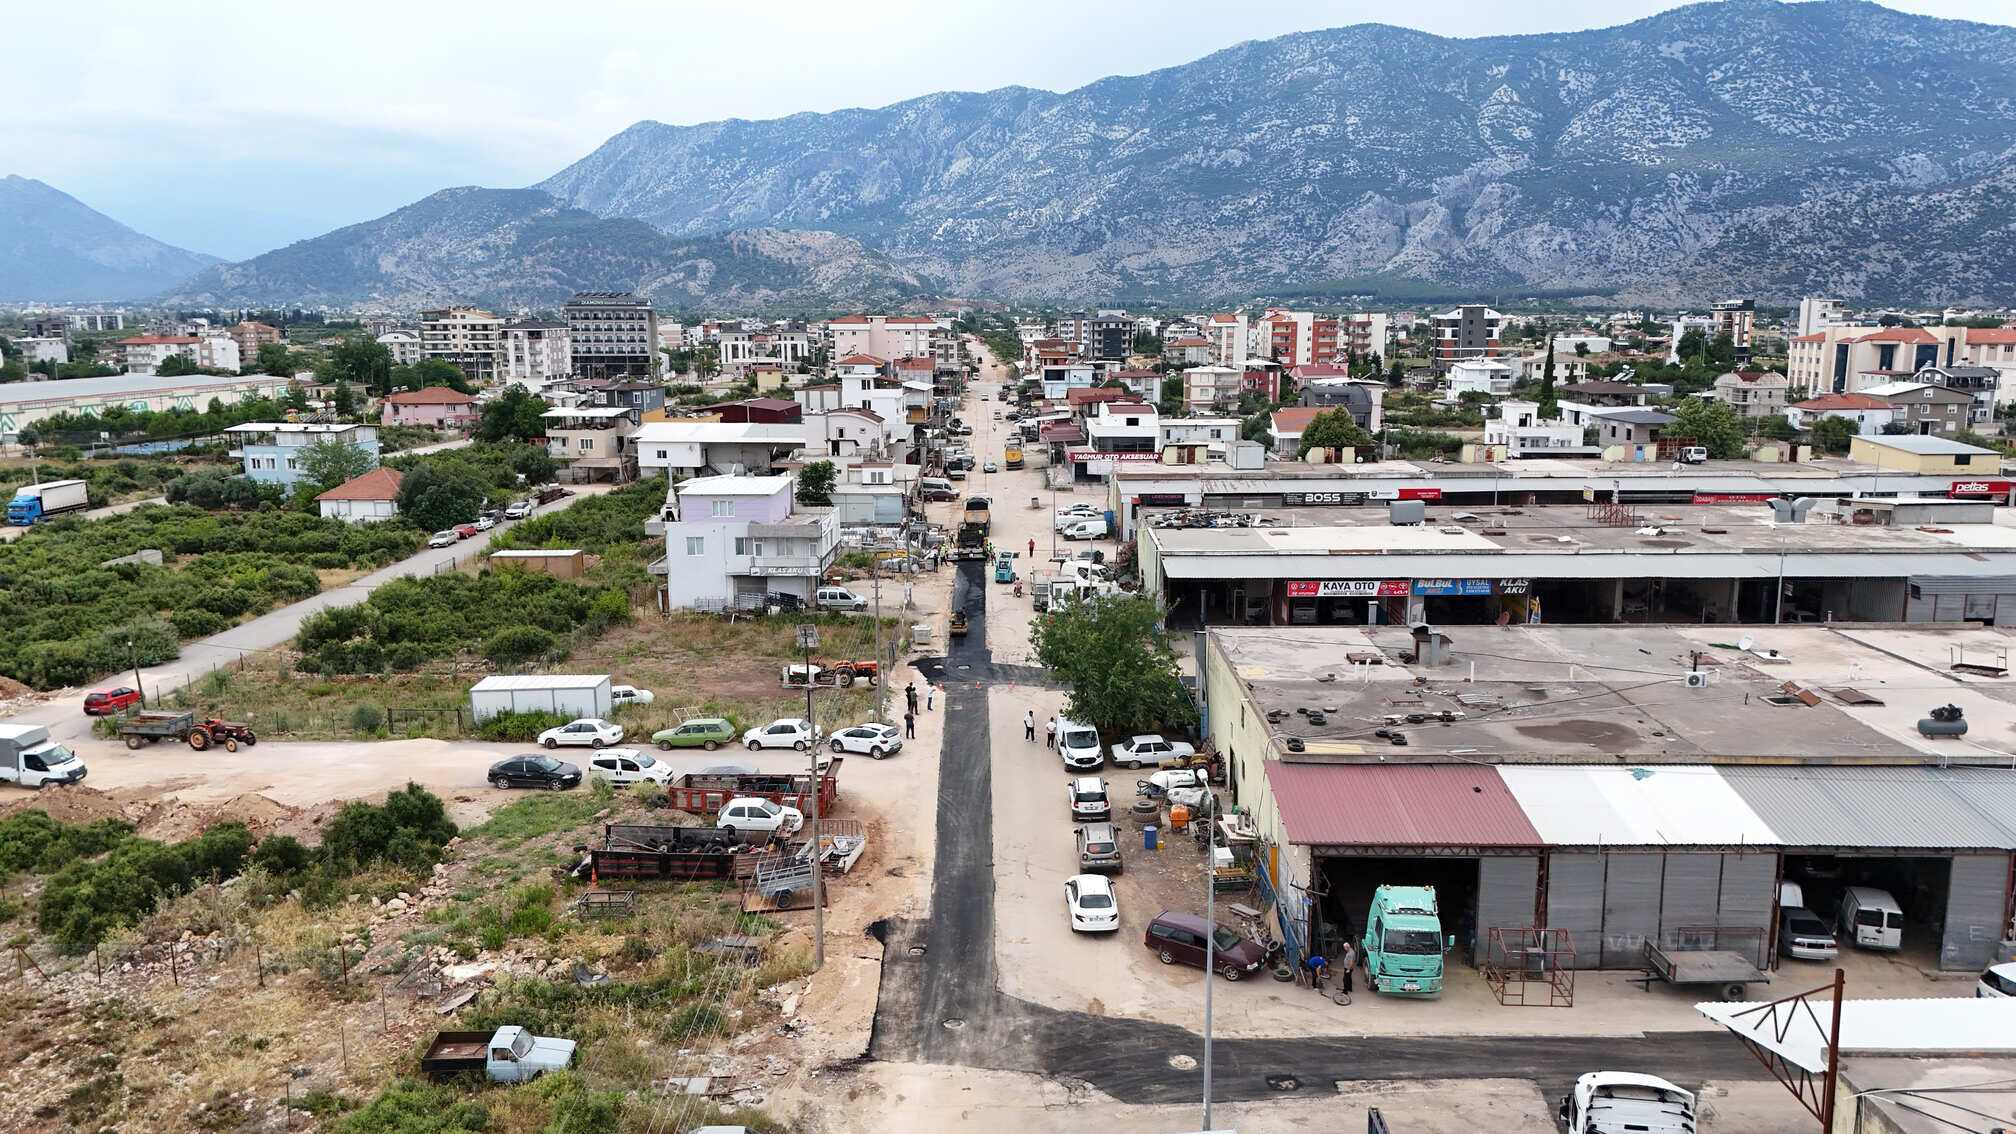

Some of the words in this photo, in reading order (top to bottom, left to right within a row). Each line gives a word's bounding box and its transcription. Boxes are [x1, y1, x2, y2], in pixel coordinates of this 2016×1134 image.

[1074, 452, 1103, 460] YAĞMUR
[1305, 493, 1341, 502] BOSS
[1323, 582, 1351, 590] KAYA
[1354, 582, 1375, 590] OTO
[1500, 578, 1529, 587] KLAS
